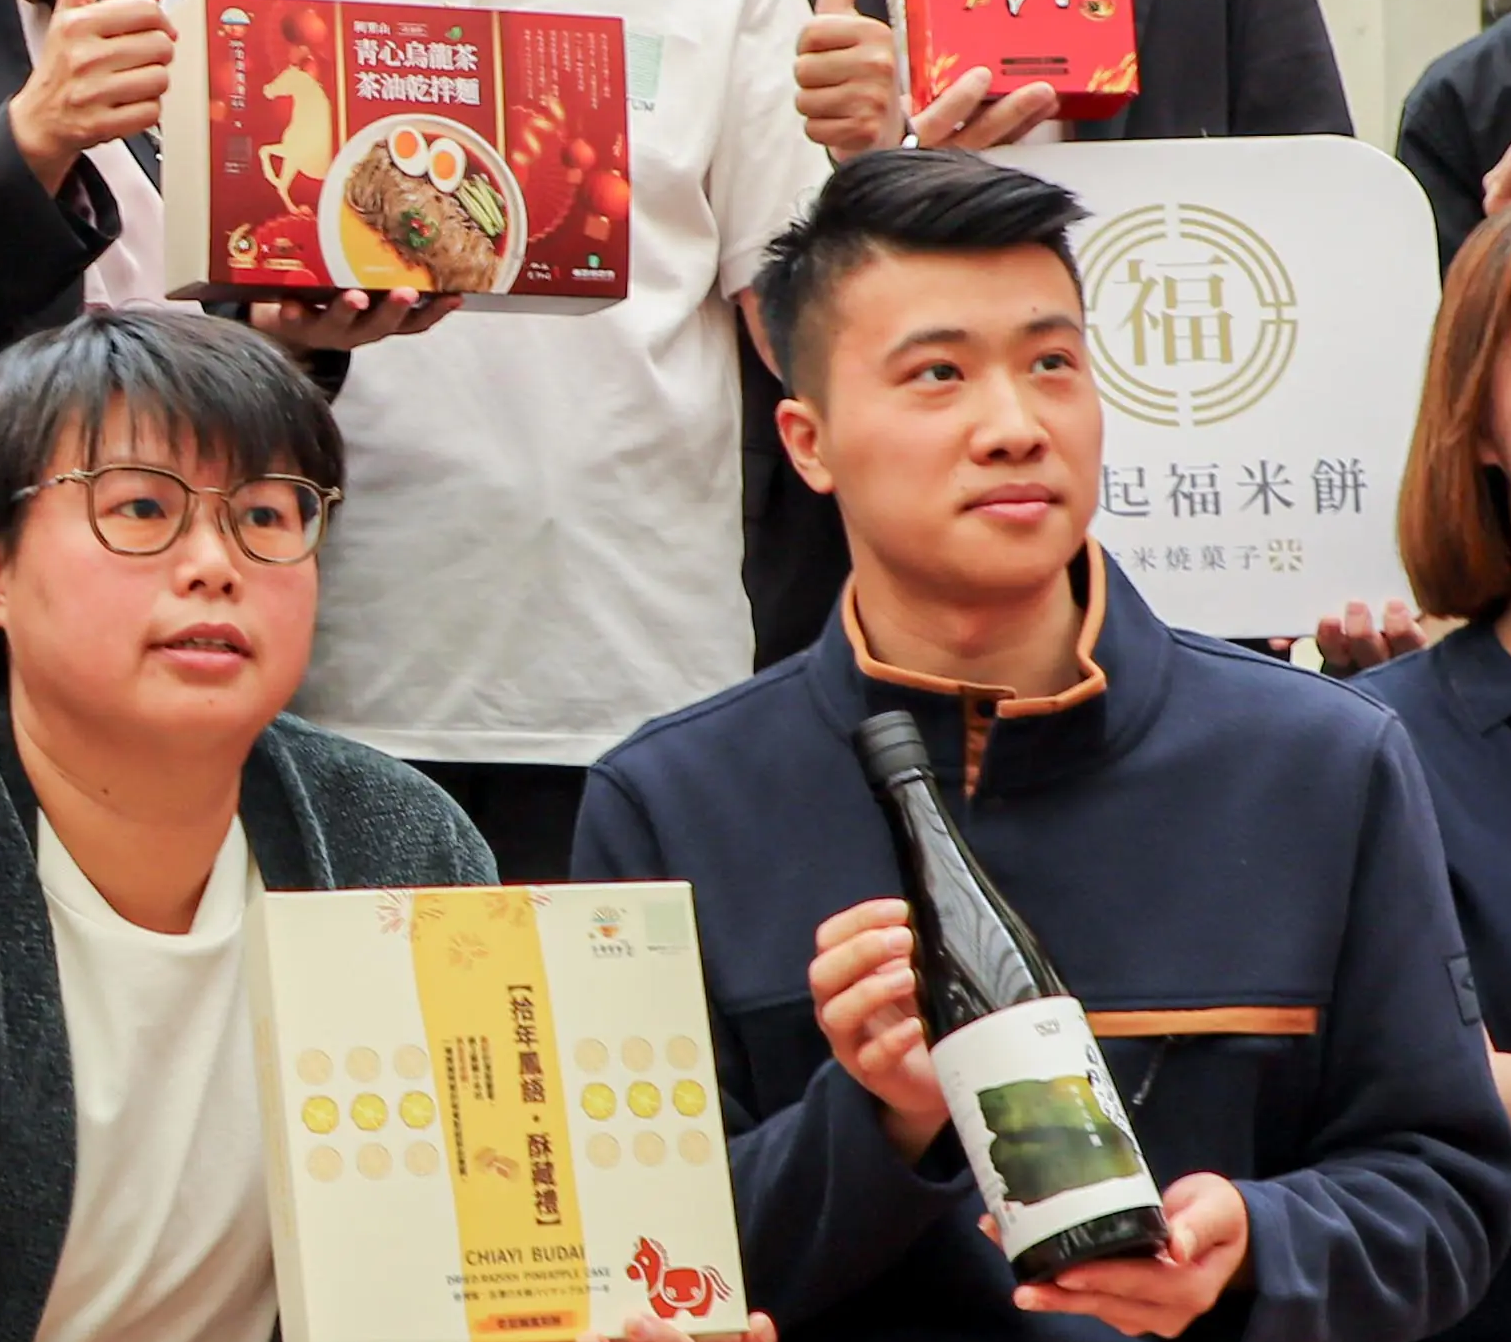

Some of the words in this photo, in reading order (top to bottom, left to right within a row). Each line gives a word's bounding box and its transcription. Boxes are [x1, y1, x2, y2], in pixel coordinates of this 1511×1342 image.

[1113, 254, 1235, 368] 福
[1099, 458, 1369, 518] 起福米餅
[1112, 544, 1262, 572] 米燒菓子
[465, 1247, 524, 1266] CHIAYI
[530, 1243, 586, 1263] BUDAI
